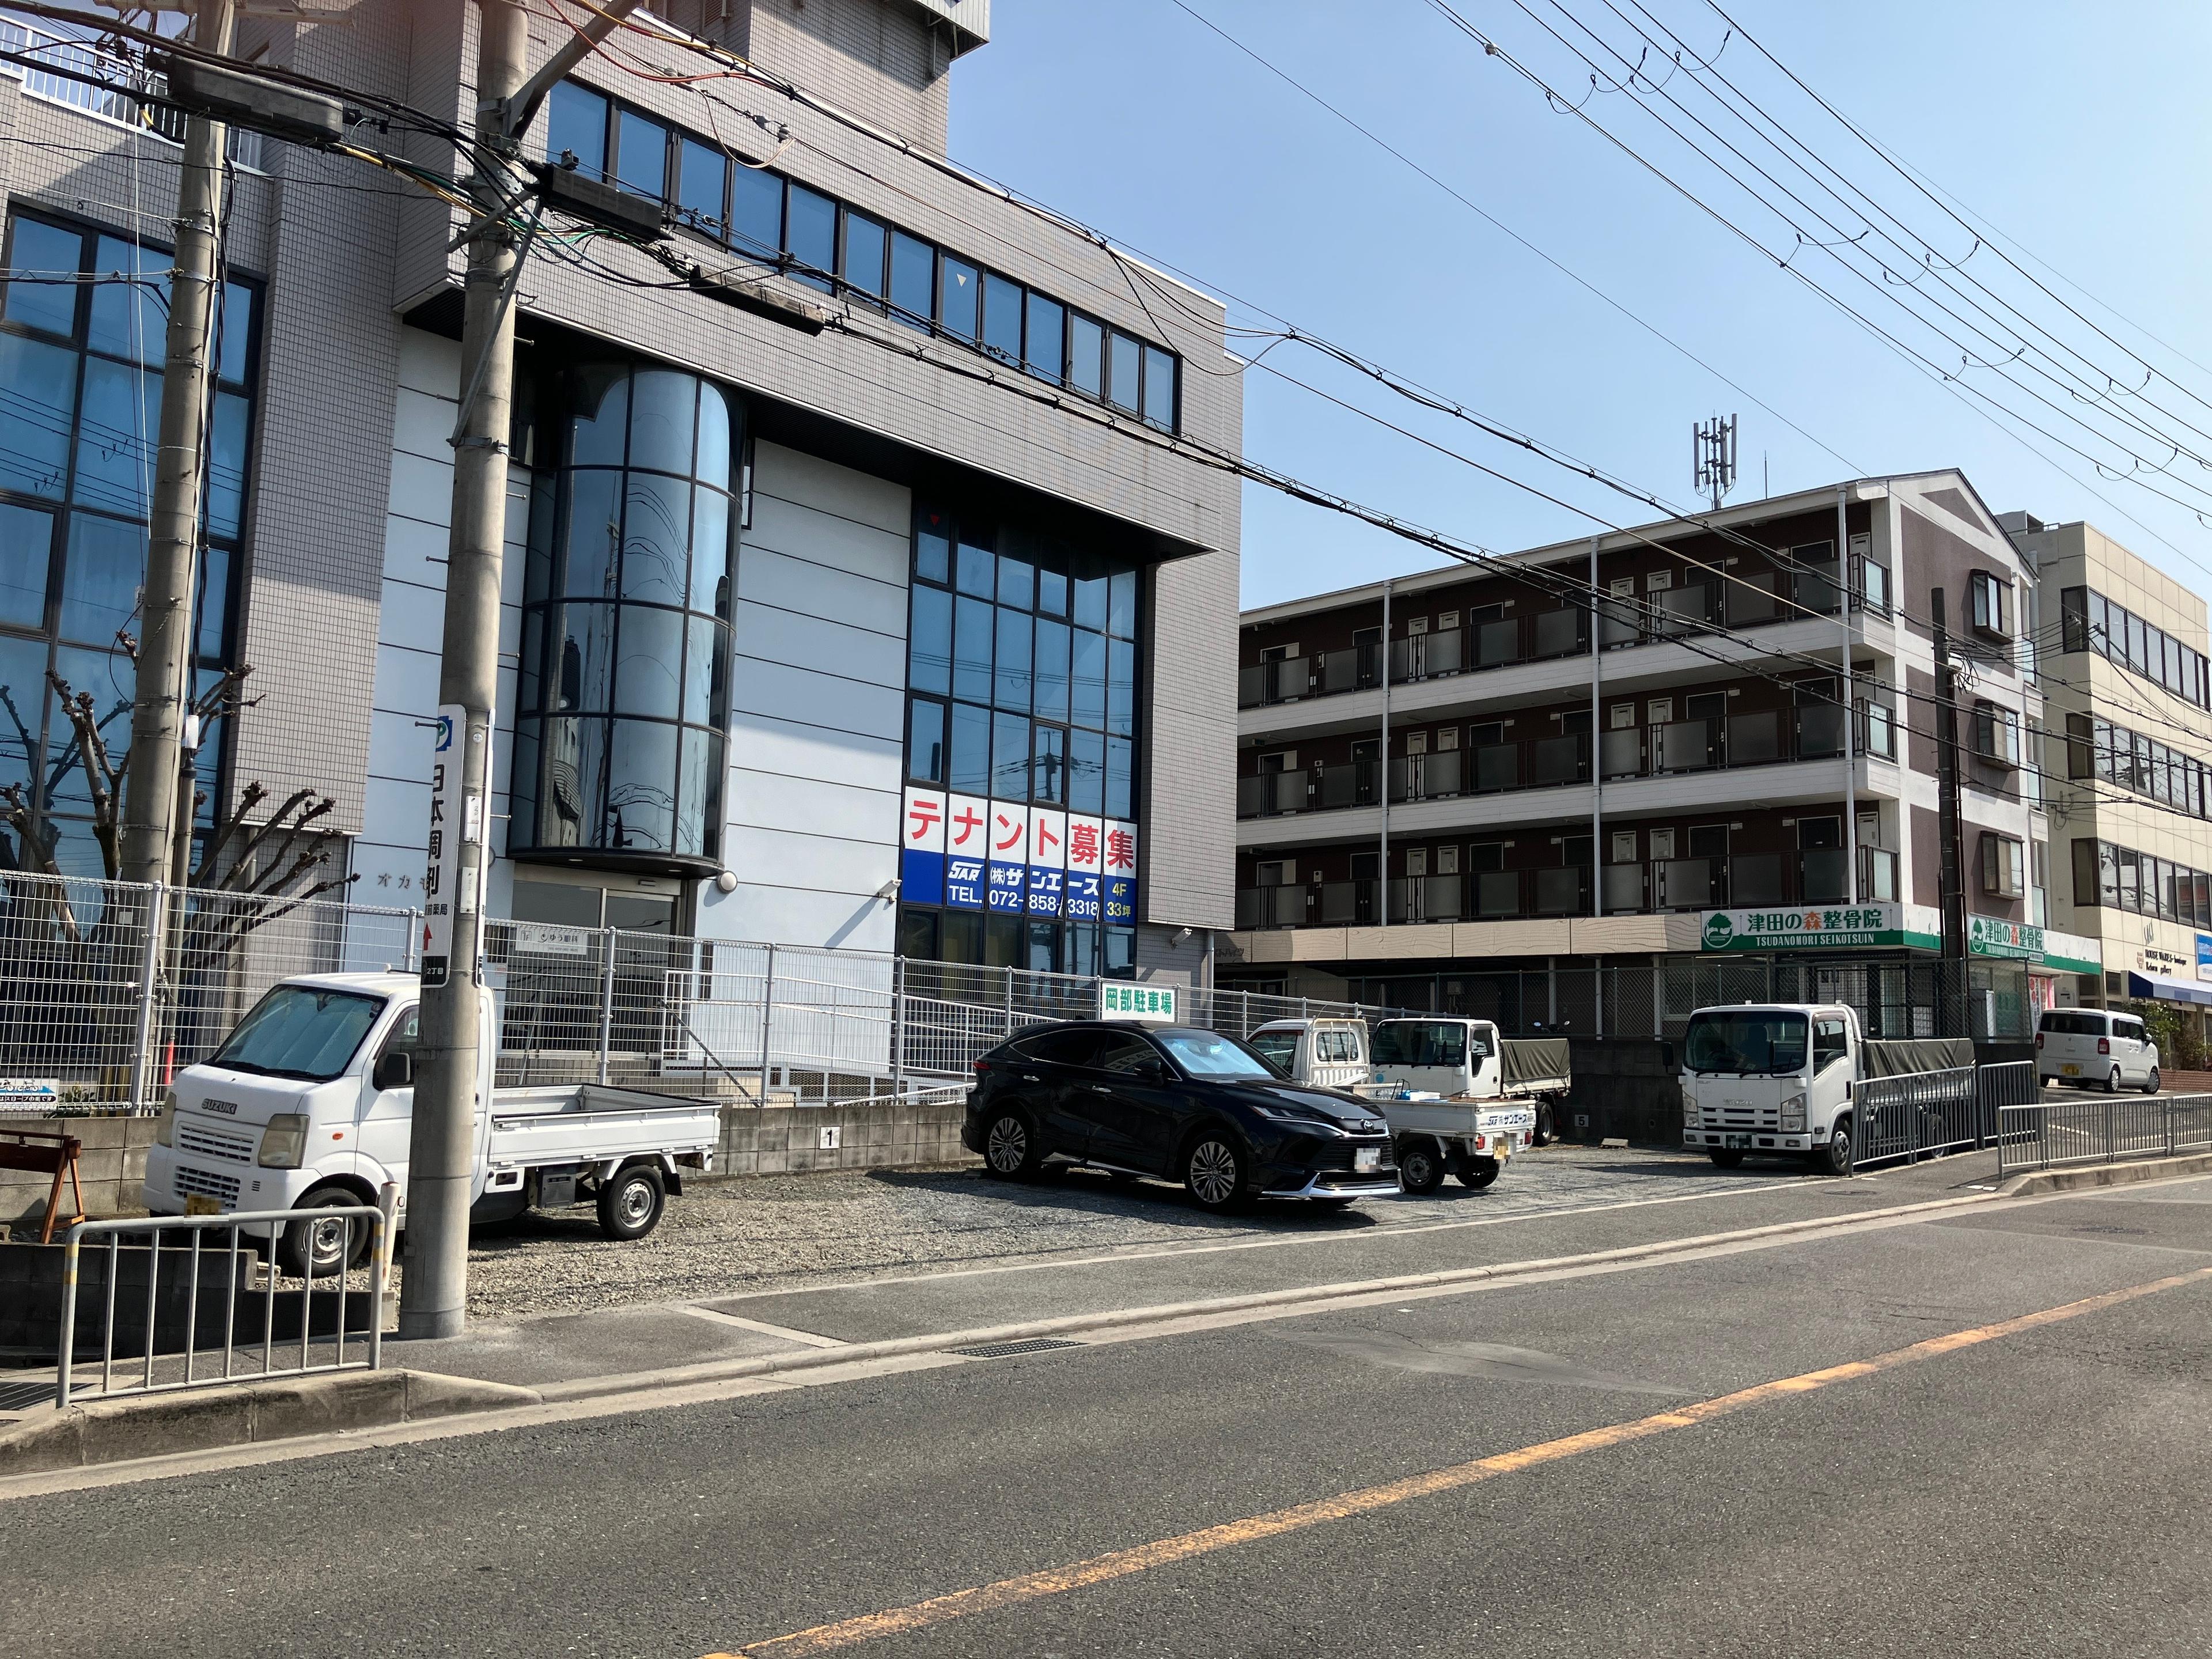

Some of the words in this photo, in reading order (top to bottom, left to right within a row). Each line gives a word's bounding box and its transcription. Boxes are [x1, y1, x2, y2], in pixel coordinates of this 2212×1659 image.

[910, 800, 1134, 869] テナント募集
[949, 885, 982, 904] TEL.
[1112, 882, 1127, 897] 4F
[1107, 902, 1131, 918] 33坪
[1748, 908, 1883, 932] 津田の森整骨院
[1756, 935, 1818, 947] TSUDANOMORI
[1820, 933, 1874, 945] SEIKOTSUIN
[1985, 918, 2043, 950] 津田の森整骨院
[1106, 987, 1172, 1014] 岡部駐車場
[201, 1098, 237, 1115] SUZUKI
[1578, 1116, 1585, 1126] 5
[827, 1130, 832, 1146] 1
